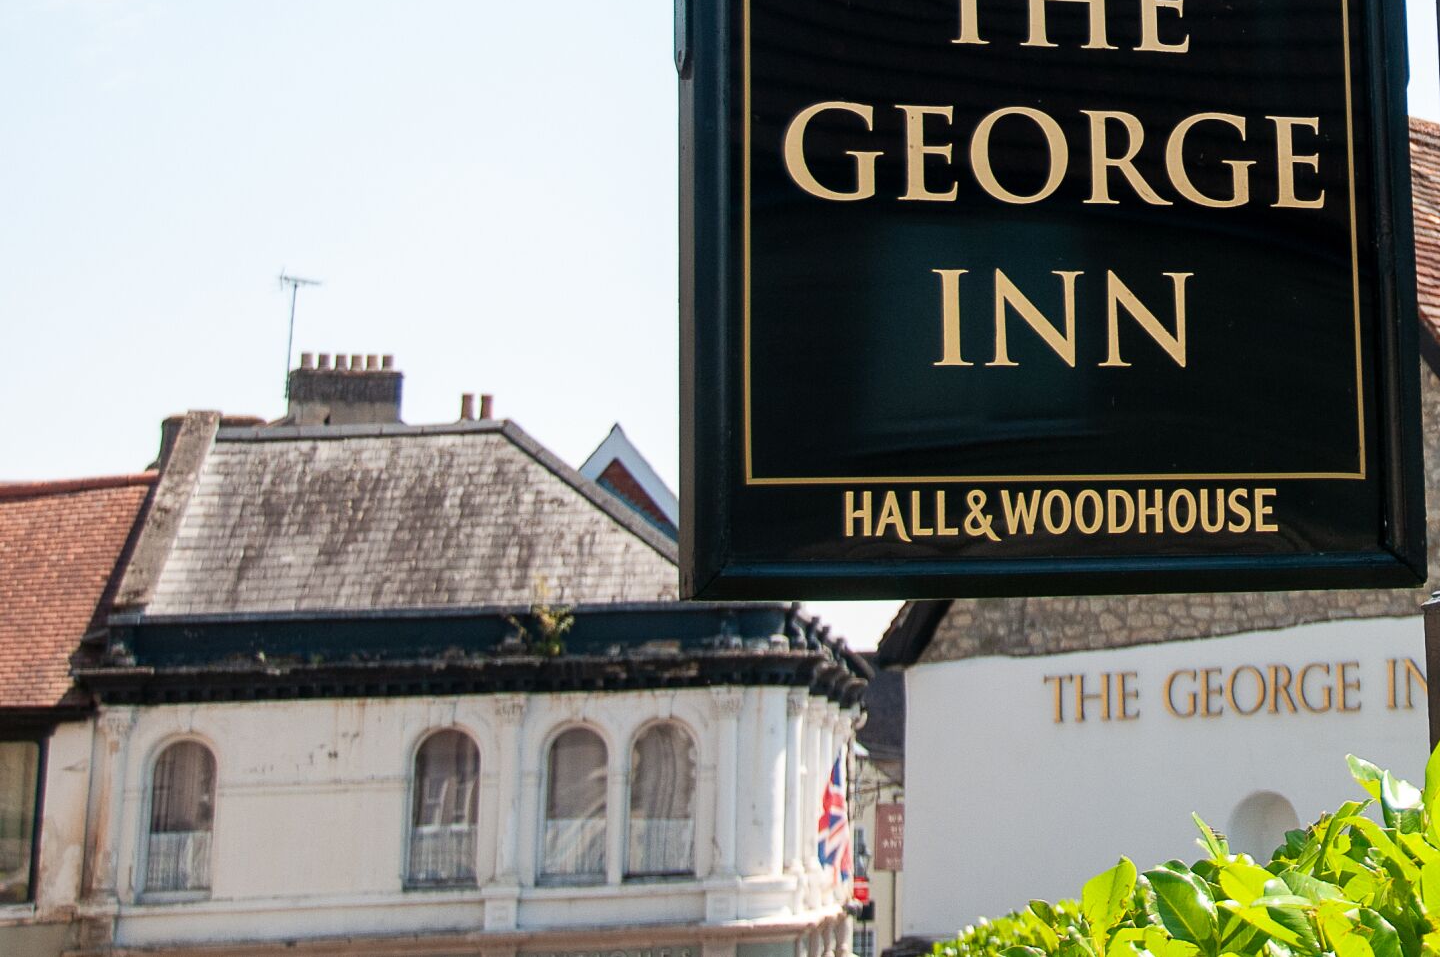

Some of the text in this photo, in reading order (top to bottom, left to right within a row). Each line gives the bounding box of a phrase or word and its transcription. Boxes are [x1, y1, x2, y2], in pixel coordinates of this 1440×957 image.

[783, 101, 1325, 209] GEORGE
[931, 267, 1195, 368] INN
[1044, 658, 1428, 724] THE GEORGE IN
